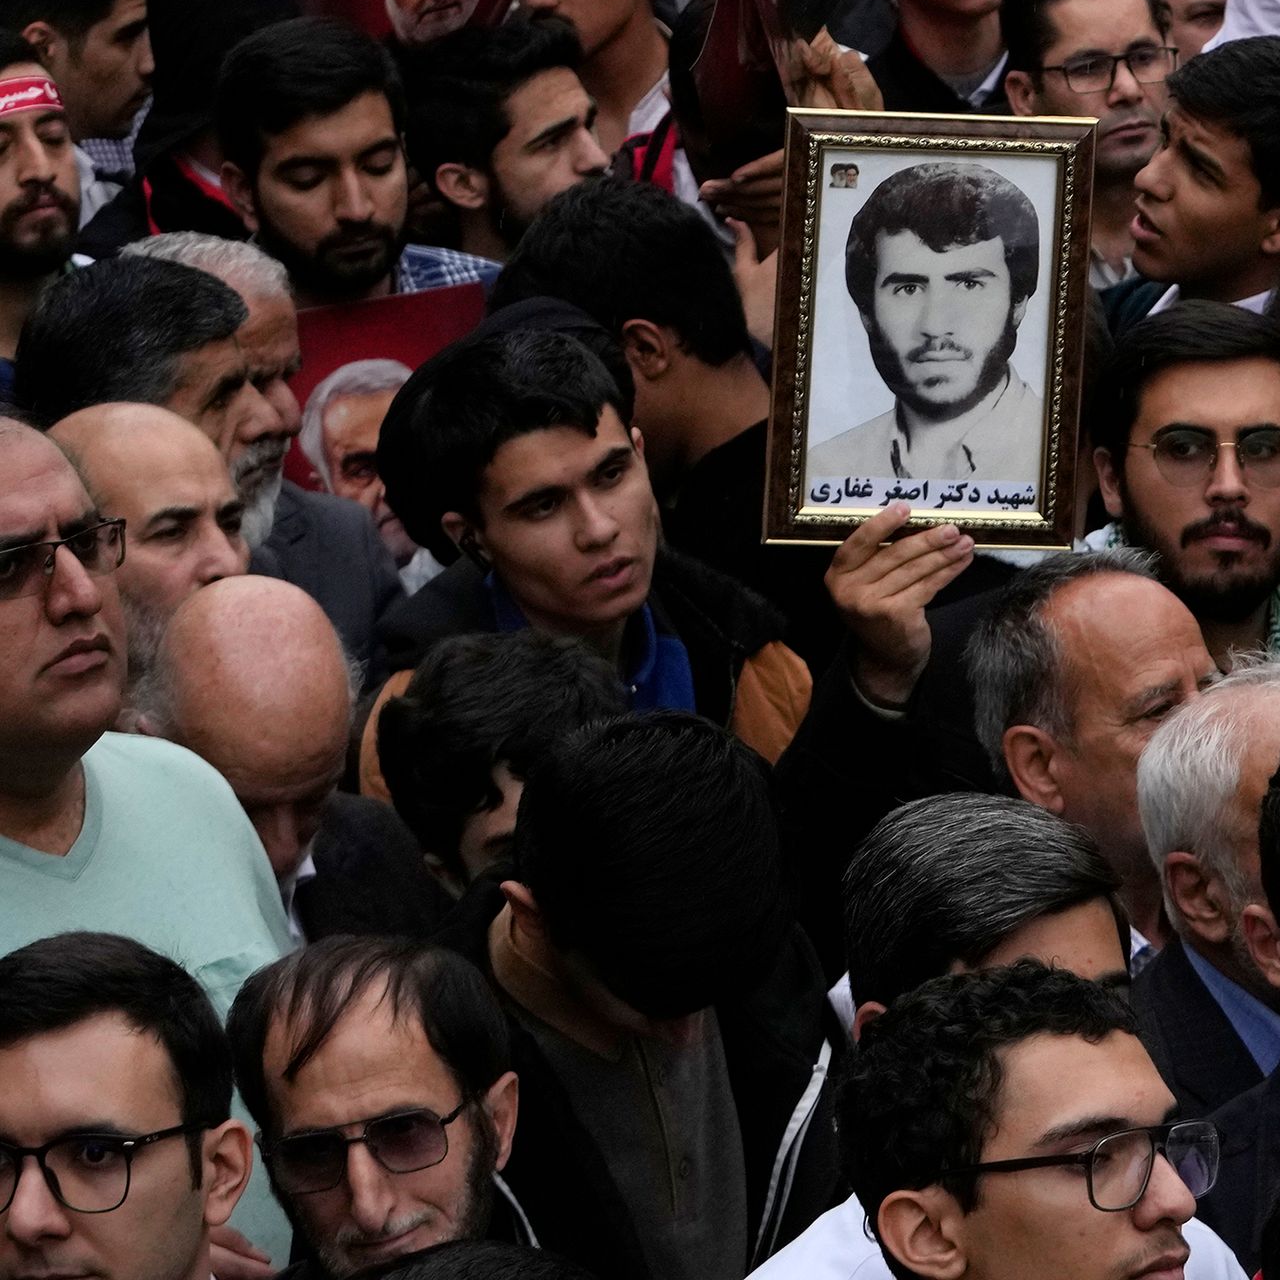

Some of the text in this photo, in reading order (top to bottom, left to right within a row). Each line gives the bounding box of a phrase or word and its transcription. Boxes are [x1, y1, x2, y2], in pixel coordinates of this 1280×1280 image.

[810, 476, 1036, 510] شهید دکتر اصغر غفاری
